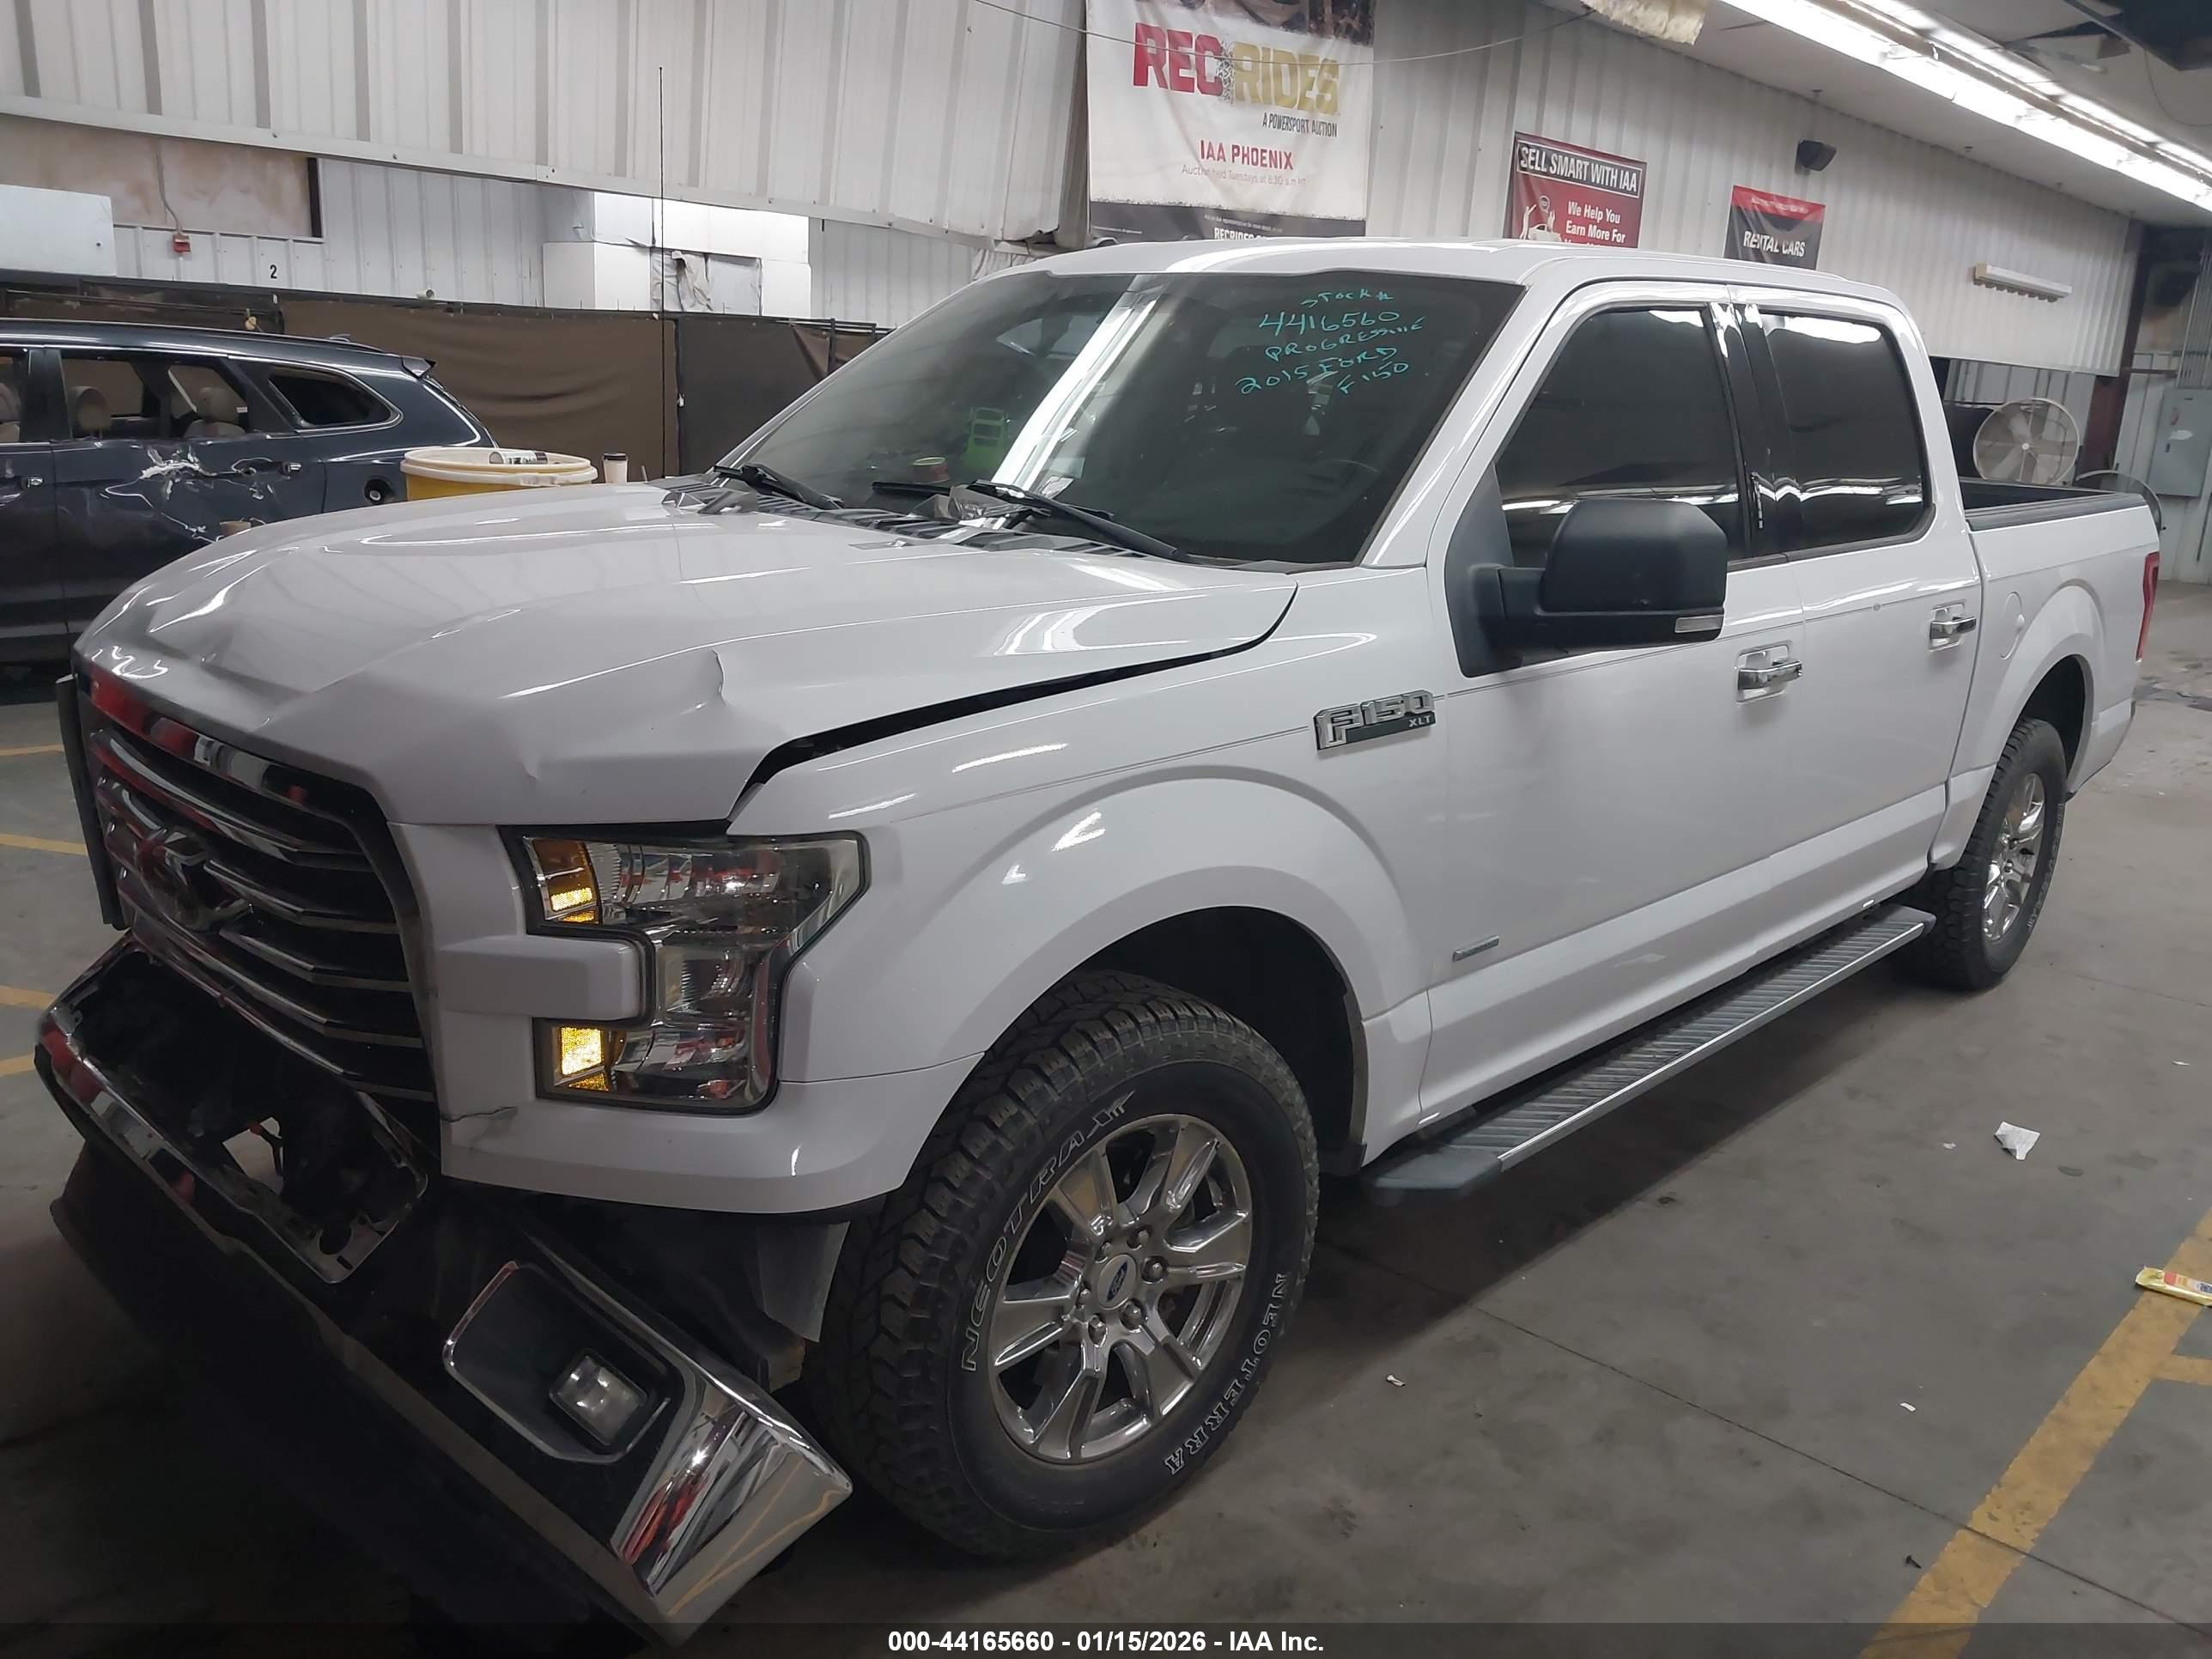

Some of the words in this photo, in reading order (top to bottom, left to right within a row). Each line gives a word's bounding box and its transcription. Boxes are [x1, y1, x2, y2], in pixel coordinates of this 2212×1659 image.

[1133, 22, 1224, 96] REC
[1231, 41, 1340, 116] RIDES
[1262, 112, 1267, 127] A
[1268, 113, 1310, 134] POWERSPORT
[1311, 120, 1337, 137] AUCTION
[1200, 140, 1226, 163] IAA
[1231, 144, 1294, 171] PHOENIX
[1520, 146, 1547, 173] SELL
[1549, 154, 1589, 181] SMART
[1591, 162, 1618, 188] WITH
[1620, 170, 1638, 192] IAA
[1568, 201, 1582, 216] We
[1583, 204, 1603, 224] Help
[1605, 208, 1621, 224] You
[1565, 220, 1585, 236] Earn
[1588, 224, 1610, 240] More
[1611, 228, 1626, 244] For
[1743, 230, 1780, 253] RENTAL
[1782, 240, 1806, 258] CARS
[270, 264, 278, 280] 2
[1259, 312, 1400, 337] 4416560
[1235, 365, 1310, 394] 2015
[1409, 714, 1431, 728] XLT
[1164, 1272, 1288, 1476] NEOTERRA
